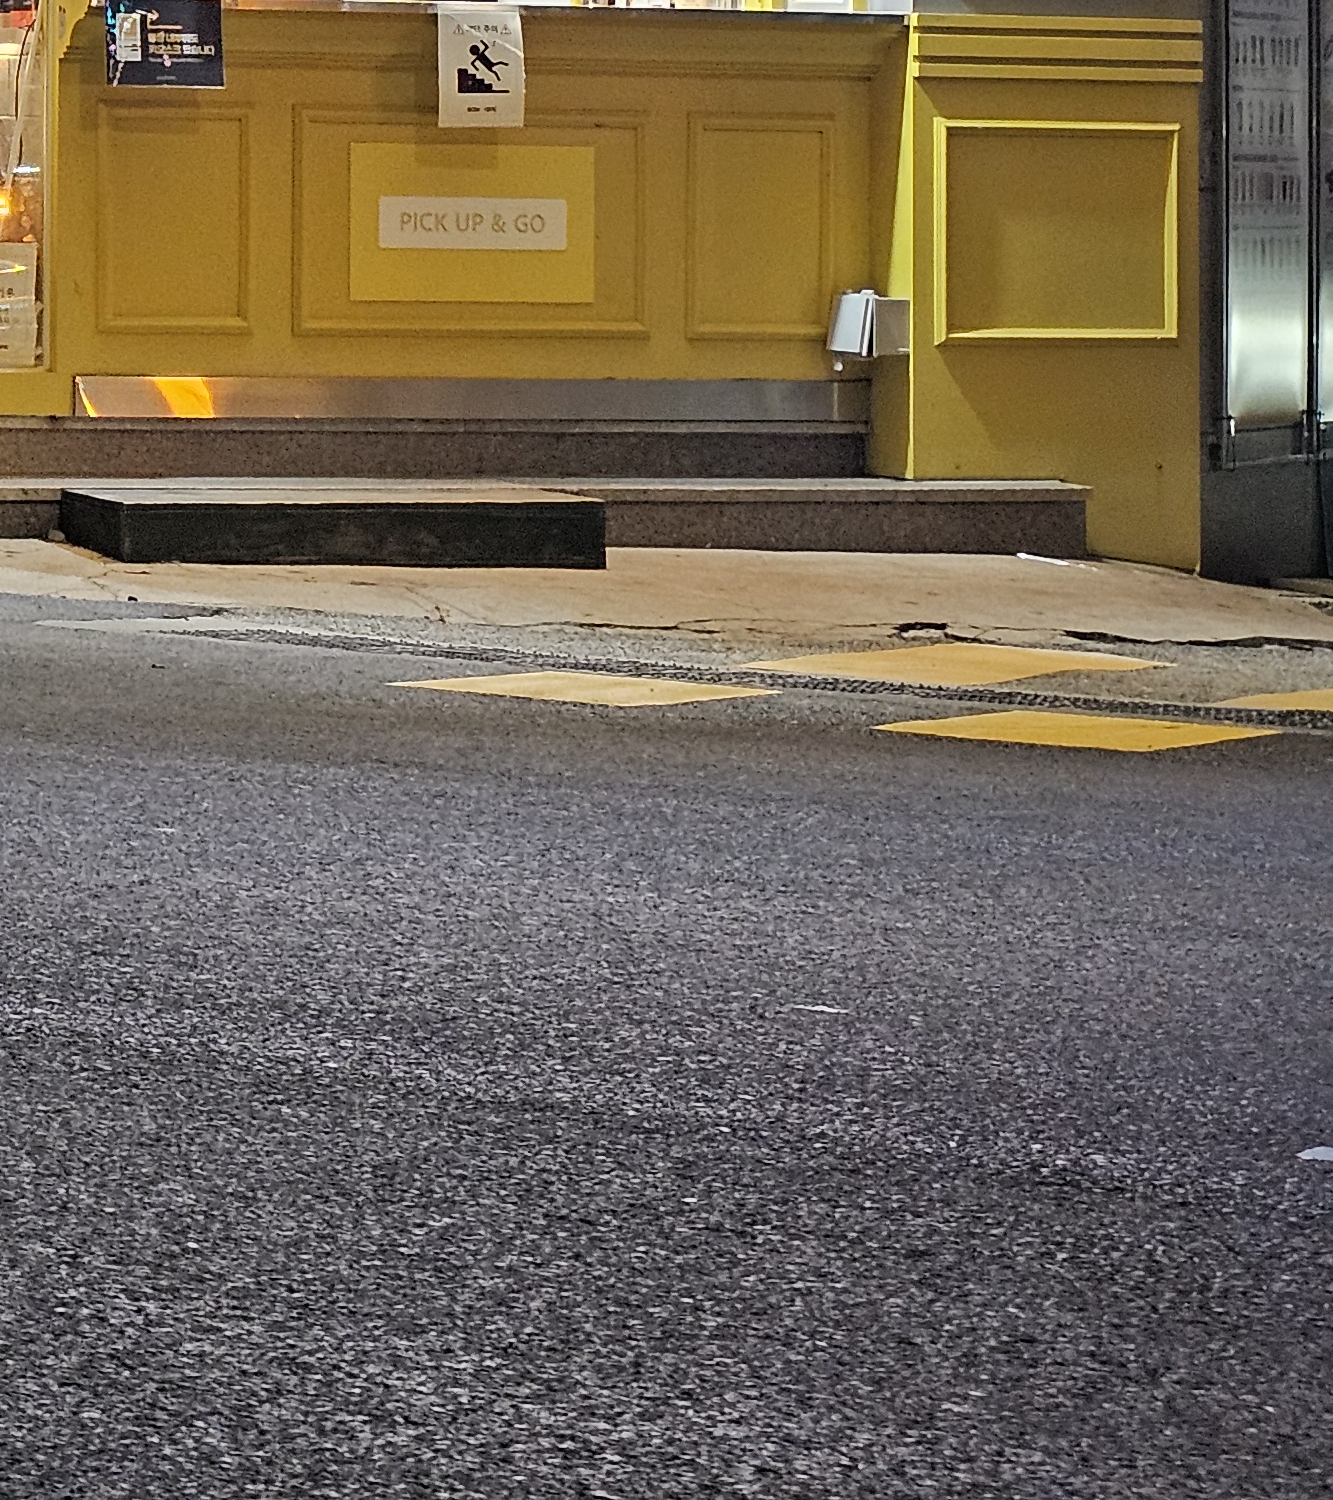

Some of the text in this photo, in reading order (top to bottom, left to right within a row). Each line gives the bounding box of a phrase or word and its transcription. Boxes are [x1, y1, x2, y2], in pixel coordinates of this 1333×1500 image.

[400, 211, 546, 233] PICK UP & GO
